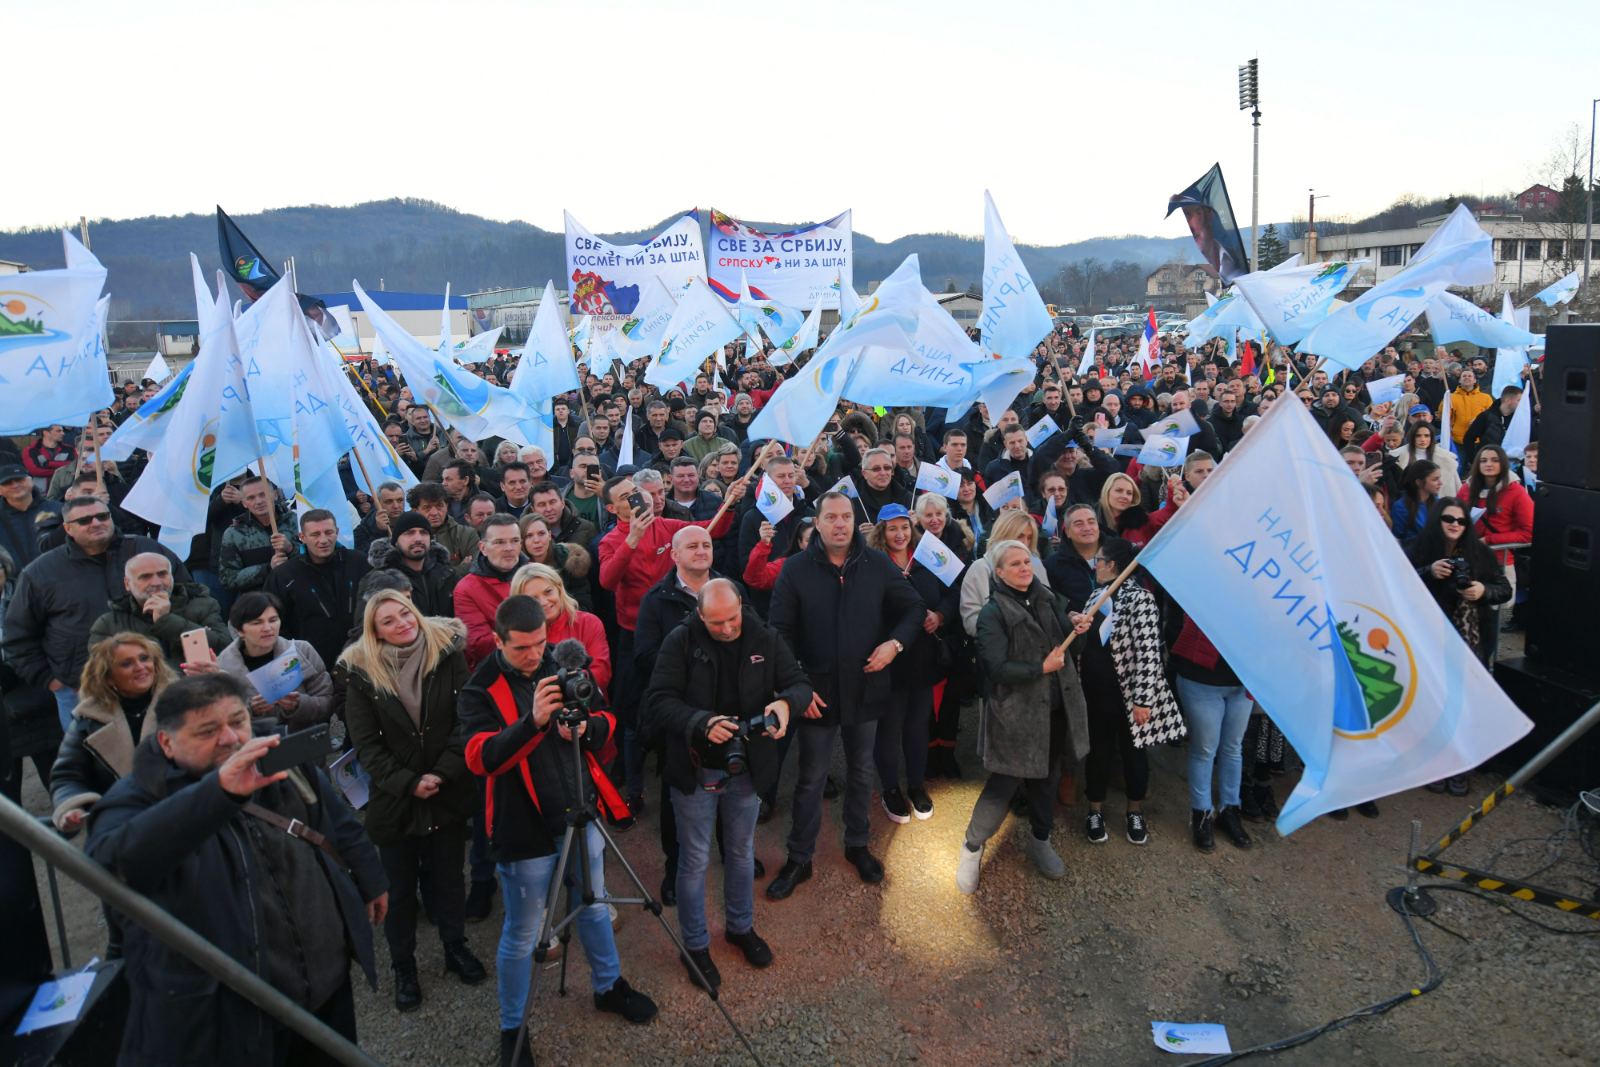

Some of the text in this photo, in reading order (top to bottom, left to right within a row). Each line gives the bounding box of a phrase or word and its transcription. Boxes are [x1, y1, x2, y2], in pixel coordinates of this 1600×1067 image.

[575, 236, 603, 251] СВЕ
[717, 238, 847, 254] СВЕ ЗА СРБИЈУ,
[649, 253, 667, 265] ЗА
[670, 250, 700, 263] ШТА!
[718, 256, 847, 269] СРПСКУ НИ ЗА ШТА!
[913, 342, 952, 364] АША
